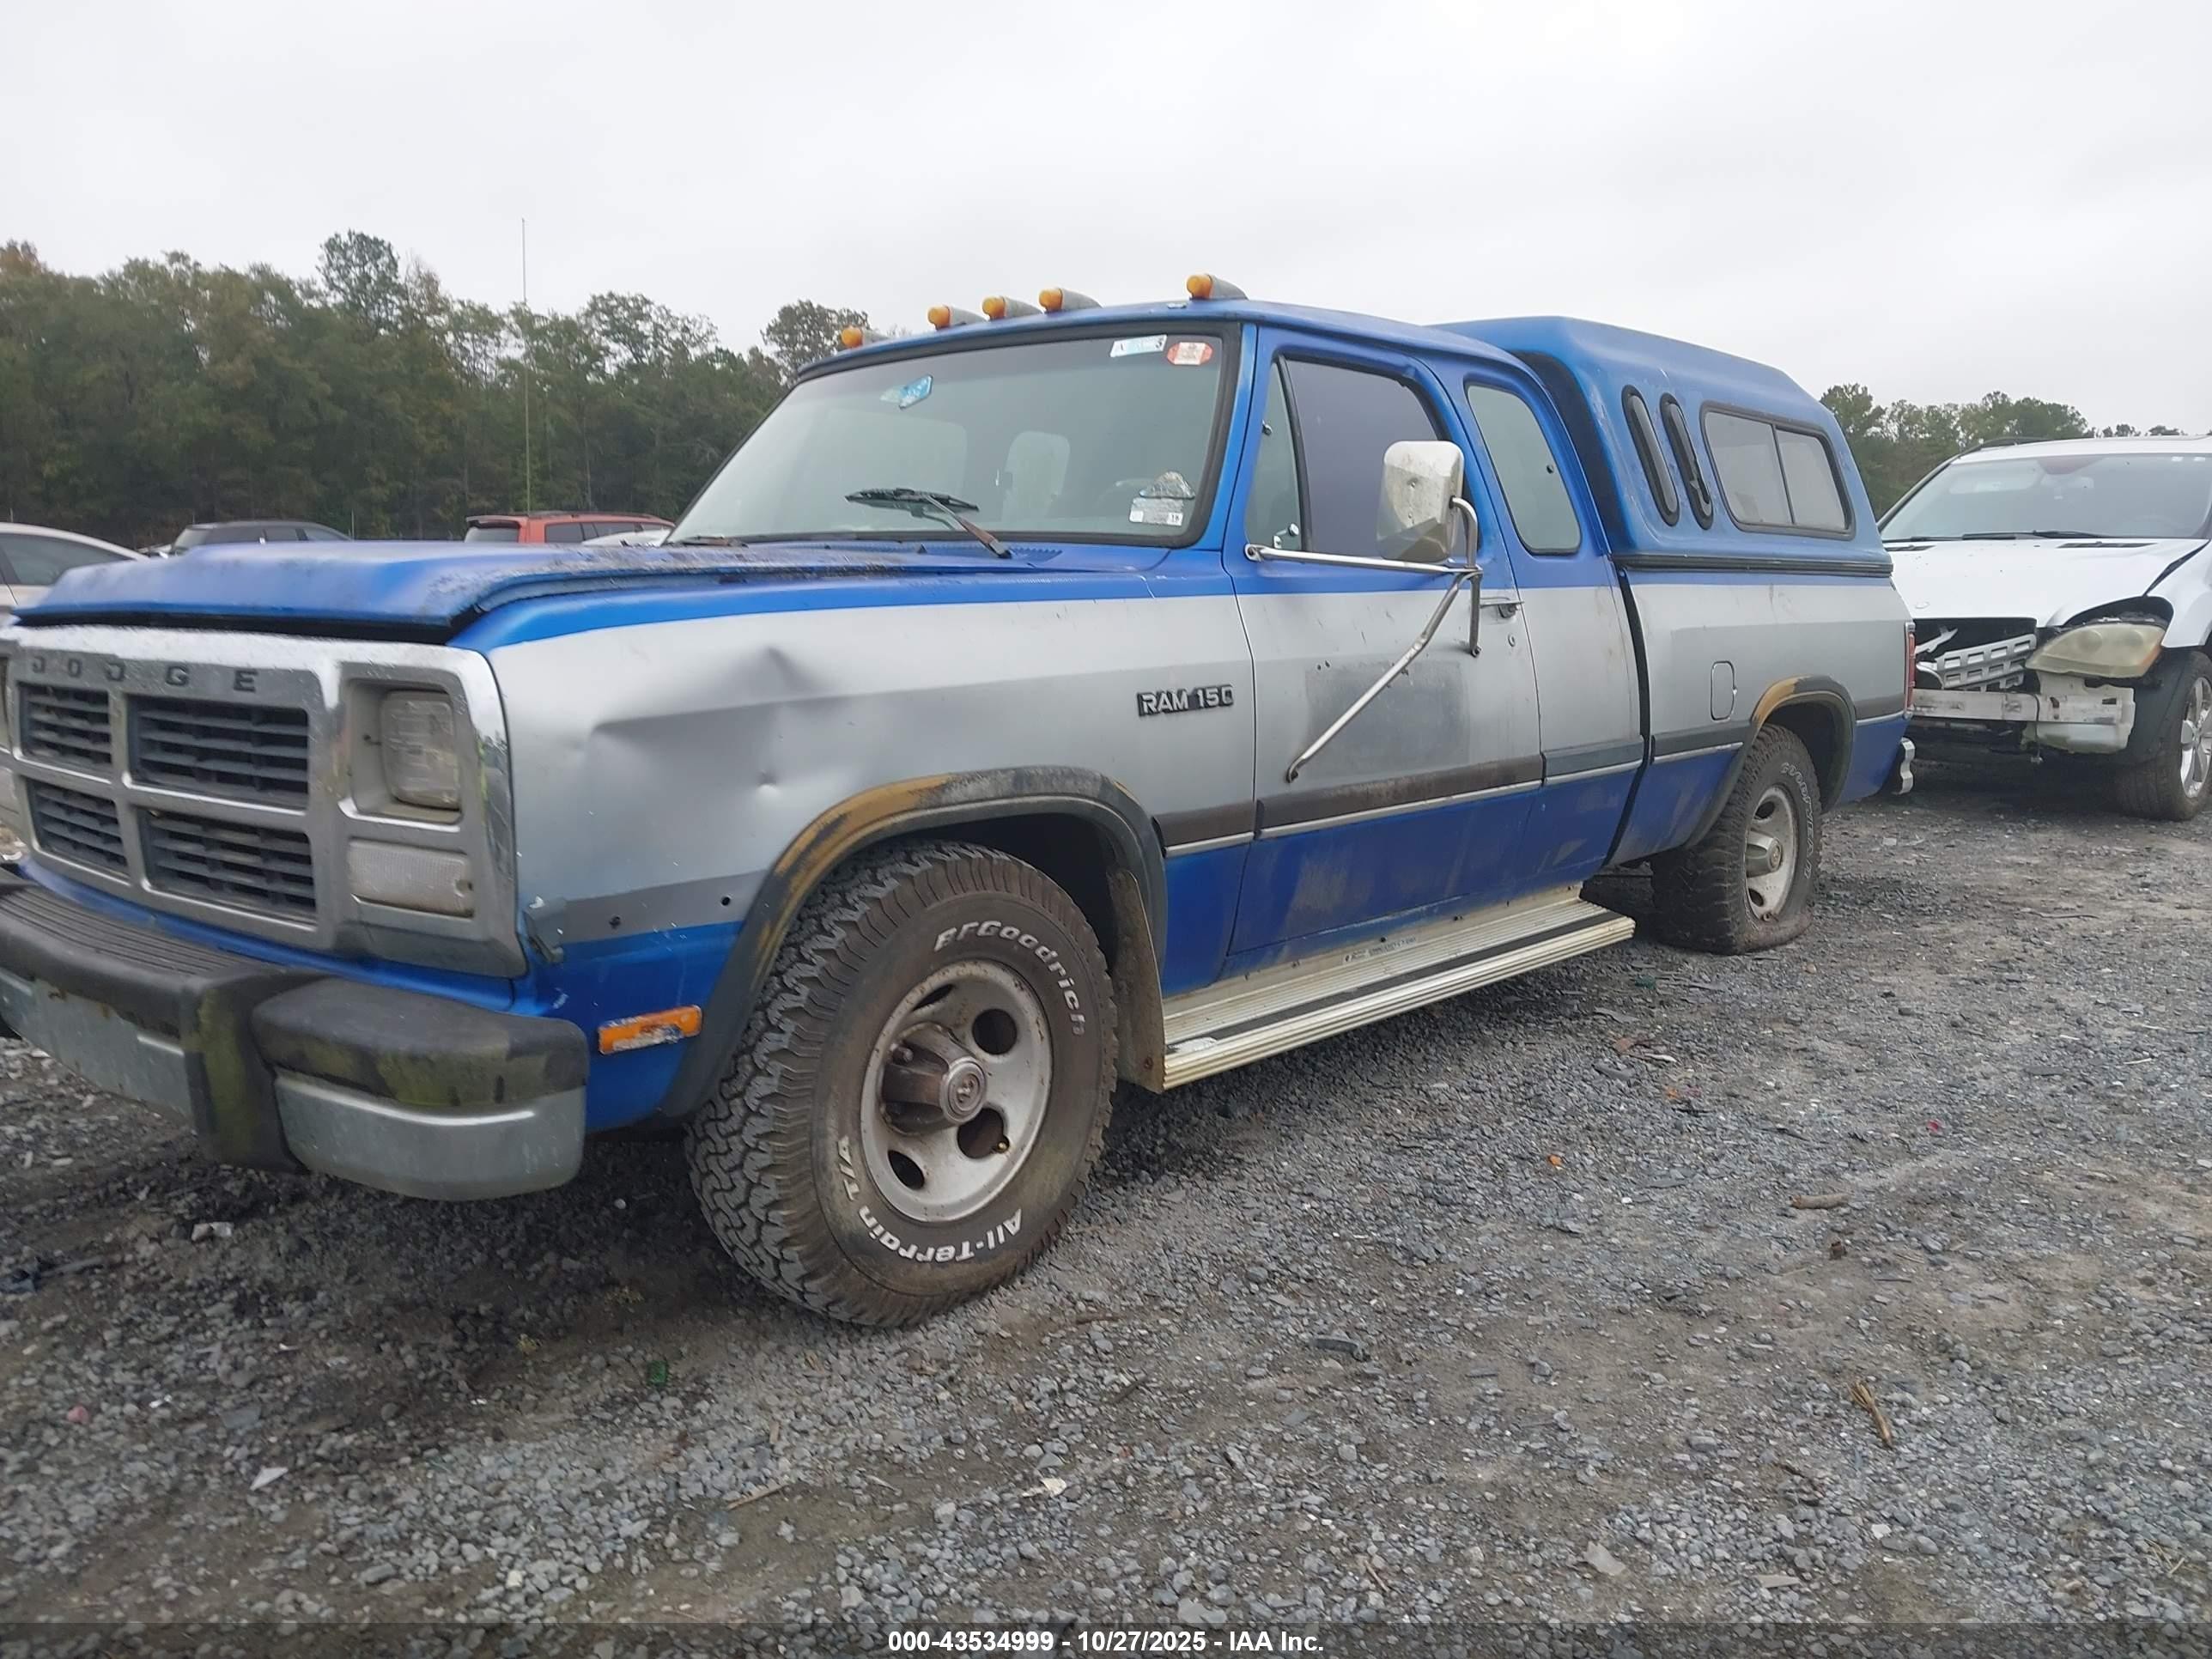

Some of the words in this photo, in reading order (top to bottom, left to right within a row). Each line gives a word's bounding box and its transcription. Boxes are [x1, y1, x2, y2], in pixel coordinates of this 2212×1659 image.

[32, 656, 258, 692] DODGE
[1137, 688, 1190, 717] RAM
[1195, 684, 1235, 709] 150
[933, 920, 1086, 1036] BFGoodrich
[836, 1135, 860, 1201] T/A
[859, 1205, 1023, 1263] All-Terrain
